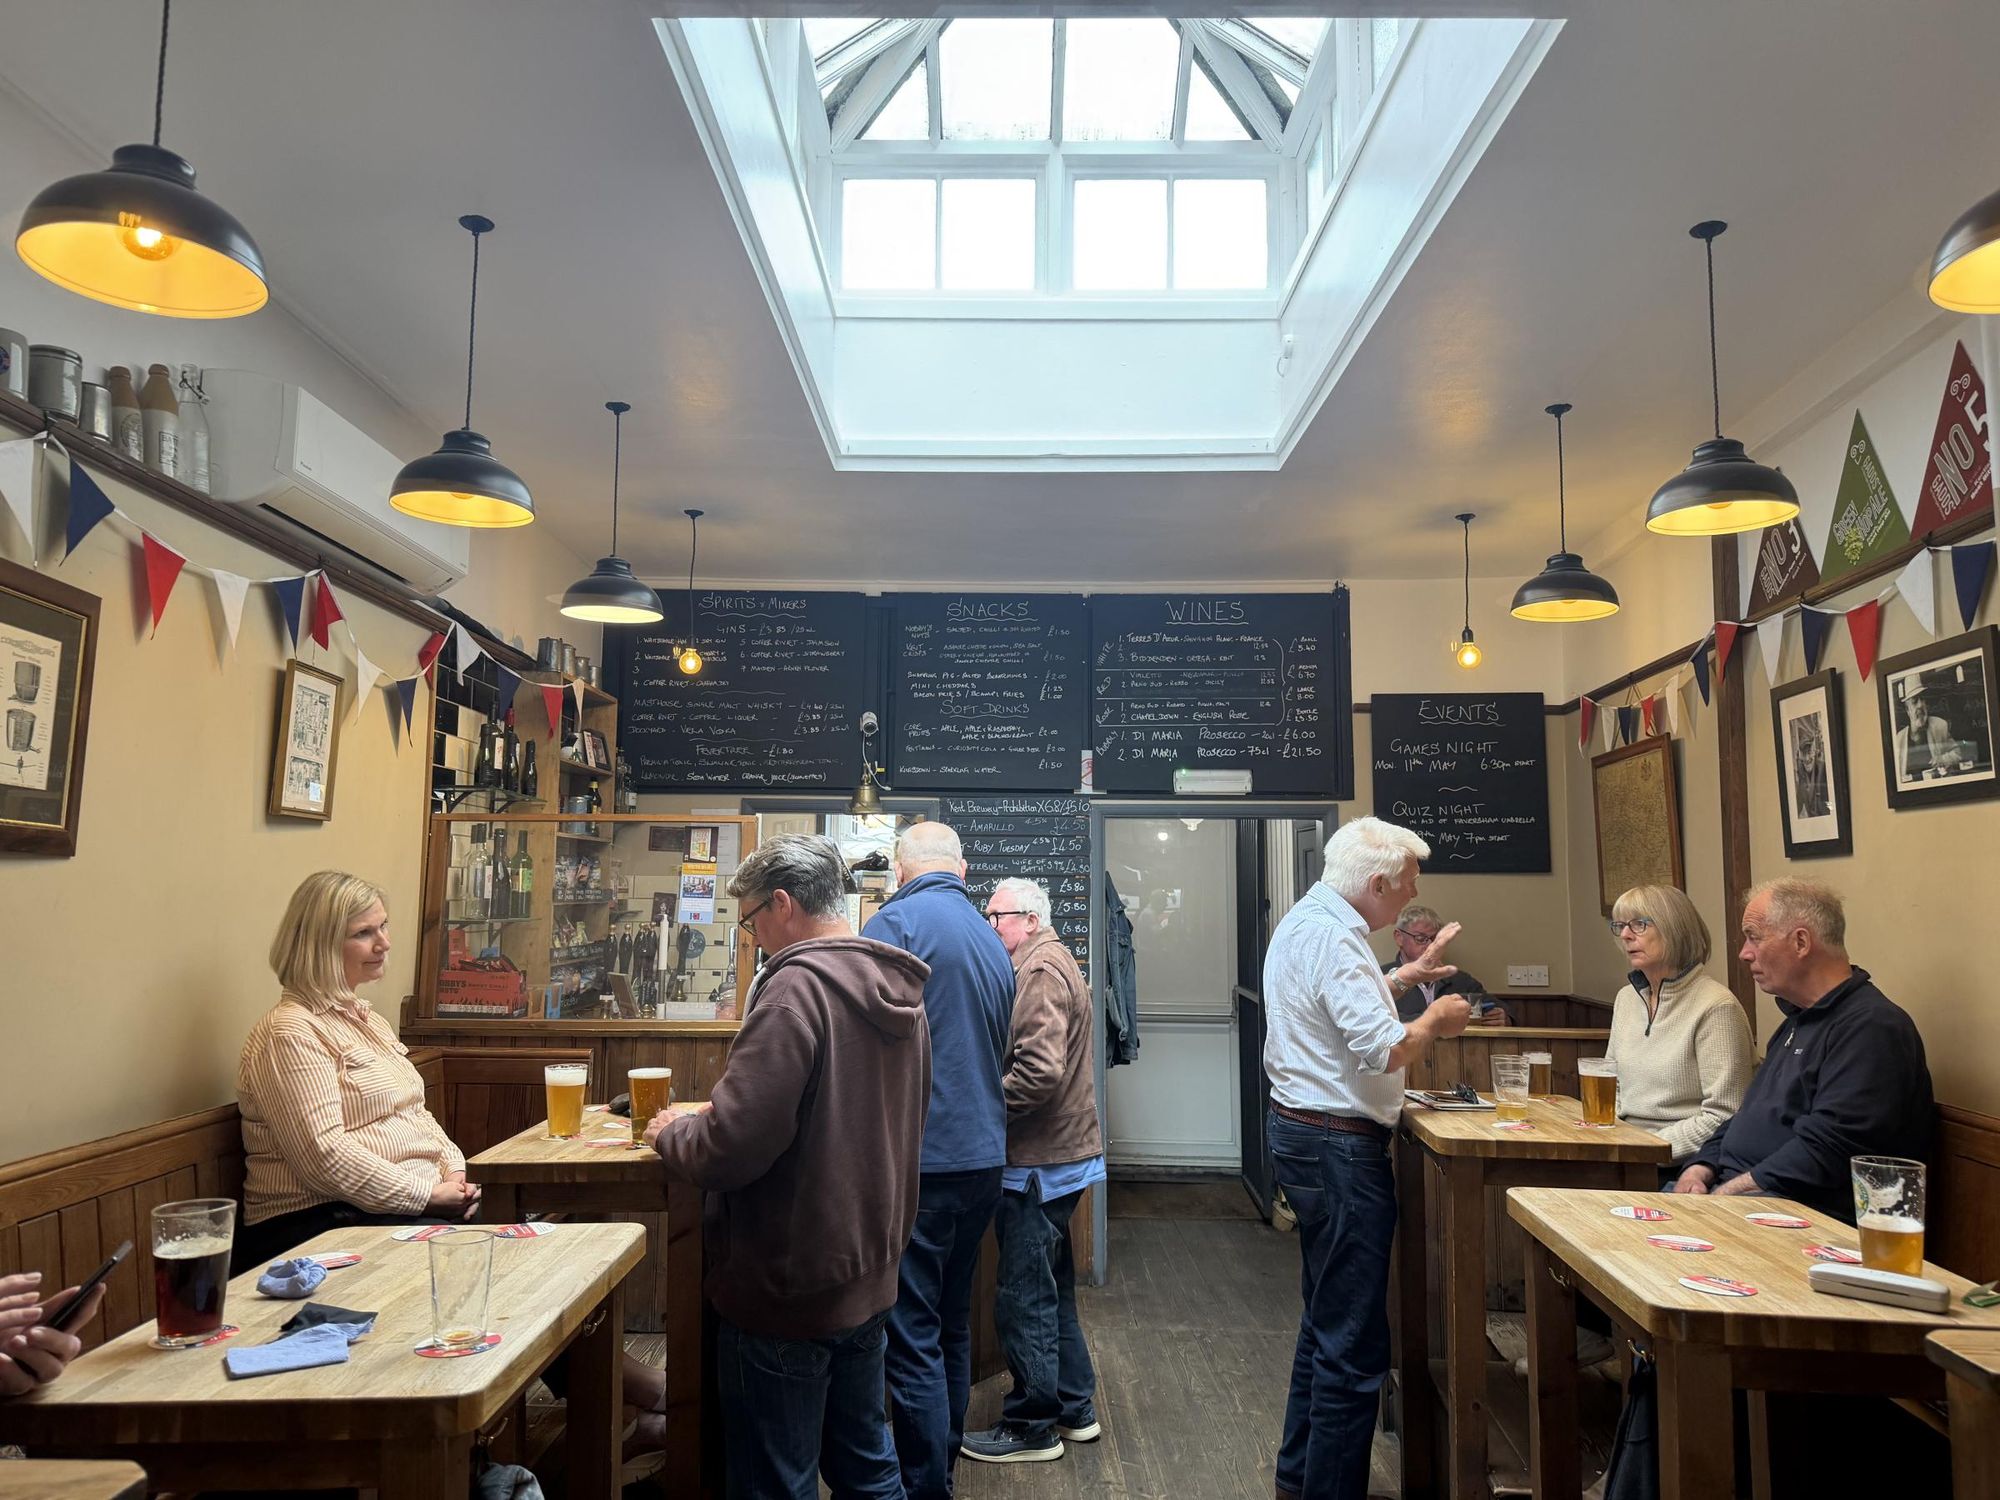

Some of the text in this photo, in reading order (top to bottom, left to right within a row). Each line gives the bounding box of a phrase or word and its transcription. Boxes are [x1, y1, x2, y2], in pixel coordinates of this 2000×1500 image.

[1933, 423, 1975, 506] NO
[1963, 390, 1990, 453] 5
[1761, 527, 1787, 595] NO
[699, 592, 807, 609] SPIRITS MIXERS
[946, 597, 1028, 617] SNACKS
[1165, 601, 1245, 621] WINES
[716, 624, 746, 634] GINS
[774, 639, 798, 647] RIVET
[1126, 632, 1152, 643] TERRES
[1129, 651, 1178, 664] BIDDENDEN
[632, 665, 640, 674] 3
[633, 679, 639, 687] 4
[643, 679, 667, 687] COPPER
[669, 679, 690, 688] RIVET
[1002, 690, 1025, 698] FRIES
[634, 698, 683, 708] MASTHOUSE
[940, 696, 1031, 714] SOFT DRINKS
[631, 713, 655, 721] COPPER
[1130, 713, 1158, 721] CHAPEL
[1192, 712, 1224, 721] ENGLISH
[1418, 700, 1499, 723] EVENTS
[1132, 731, 1145, 741] DI
[1151, 730, 1183, 741] MARIA
[1199, 726, 1246, 739] PROSECCO
[1283, 727, 1317, 740] £6.00
[1131, 748, 1145, 759] DI
[1150, 747, 1178, 758] MARIA
[1196, 746, 1237, 757] PROSECCO
[1247, 745, 1270, 756] 75cl
[1282, 742, 1322, 758] £21.50
[1389, 738, 1499, 756] GAMES NIGHT
[1428, 759, 1456, 773] MAY
[1514, 759, 1536, 767] START
[1392, 800, 1486, 817] QUIZ NIGHT
[969, 819, 1015, 832] AMARILLO
[1421, 817, 1434, 825] AID
[1454, 817, 1499, 826] FAVERSHAM
[1438, 831, 1511, 847] MAY 7pm START
[972, 839, 994, 854] RUBY
[998, 839, 1031, 854] TUESDAY
[1020, 865, 1044, 874] BATH
[1059, 878, 1085, 893] £5.80
